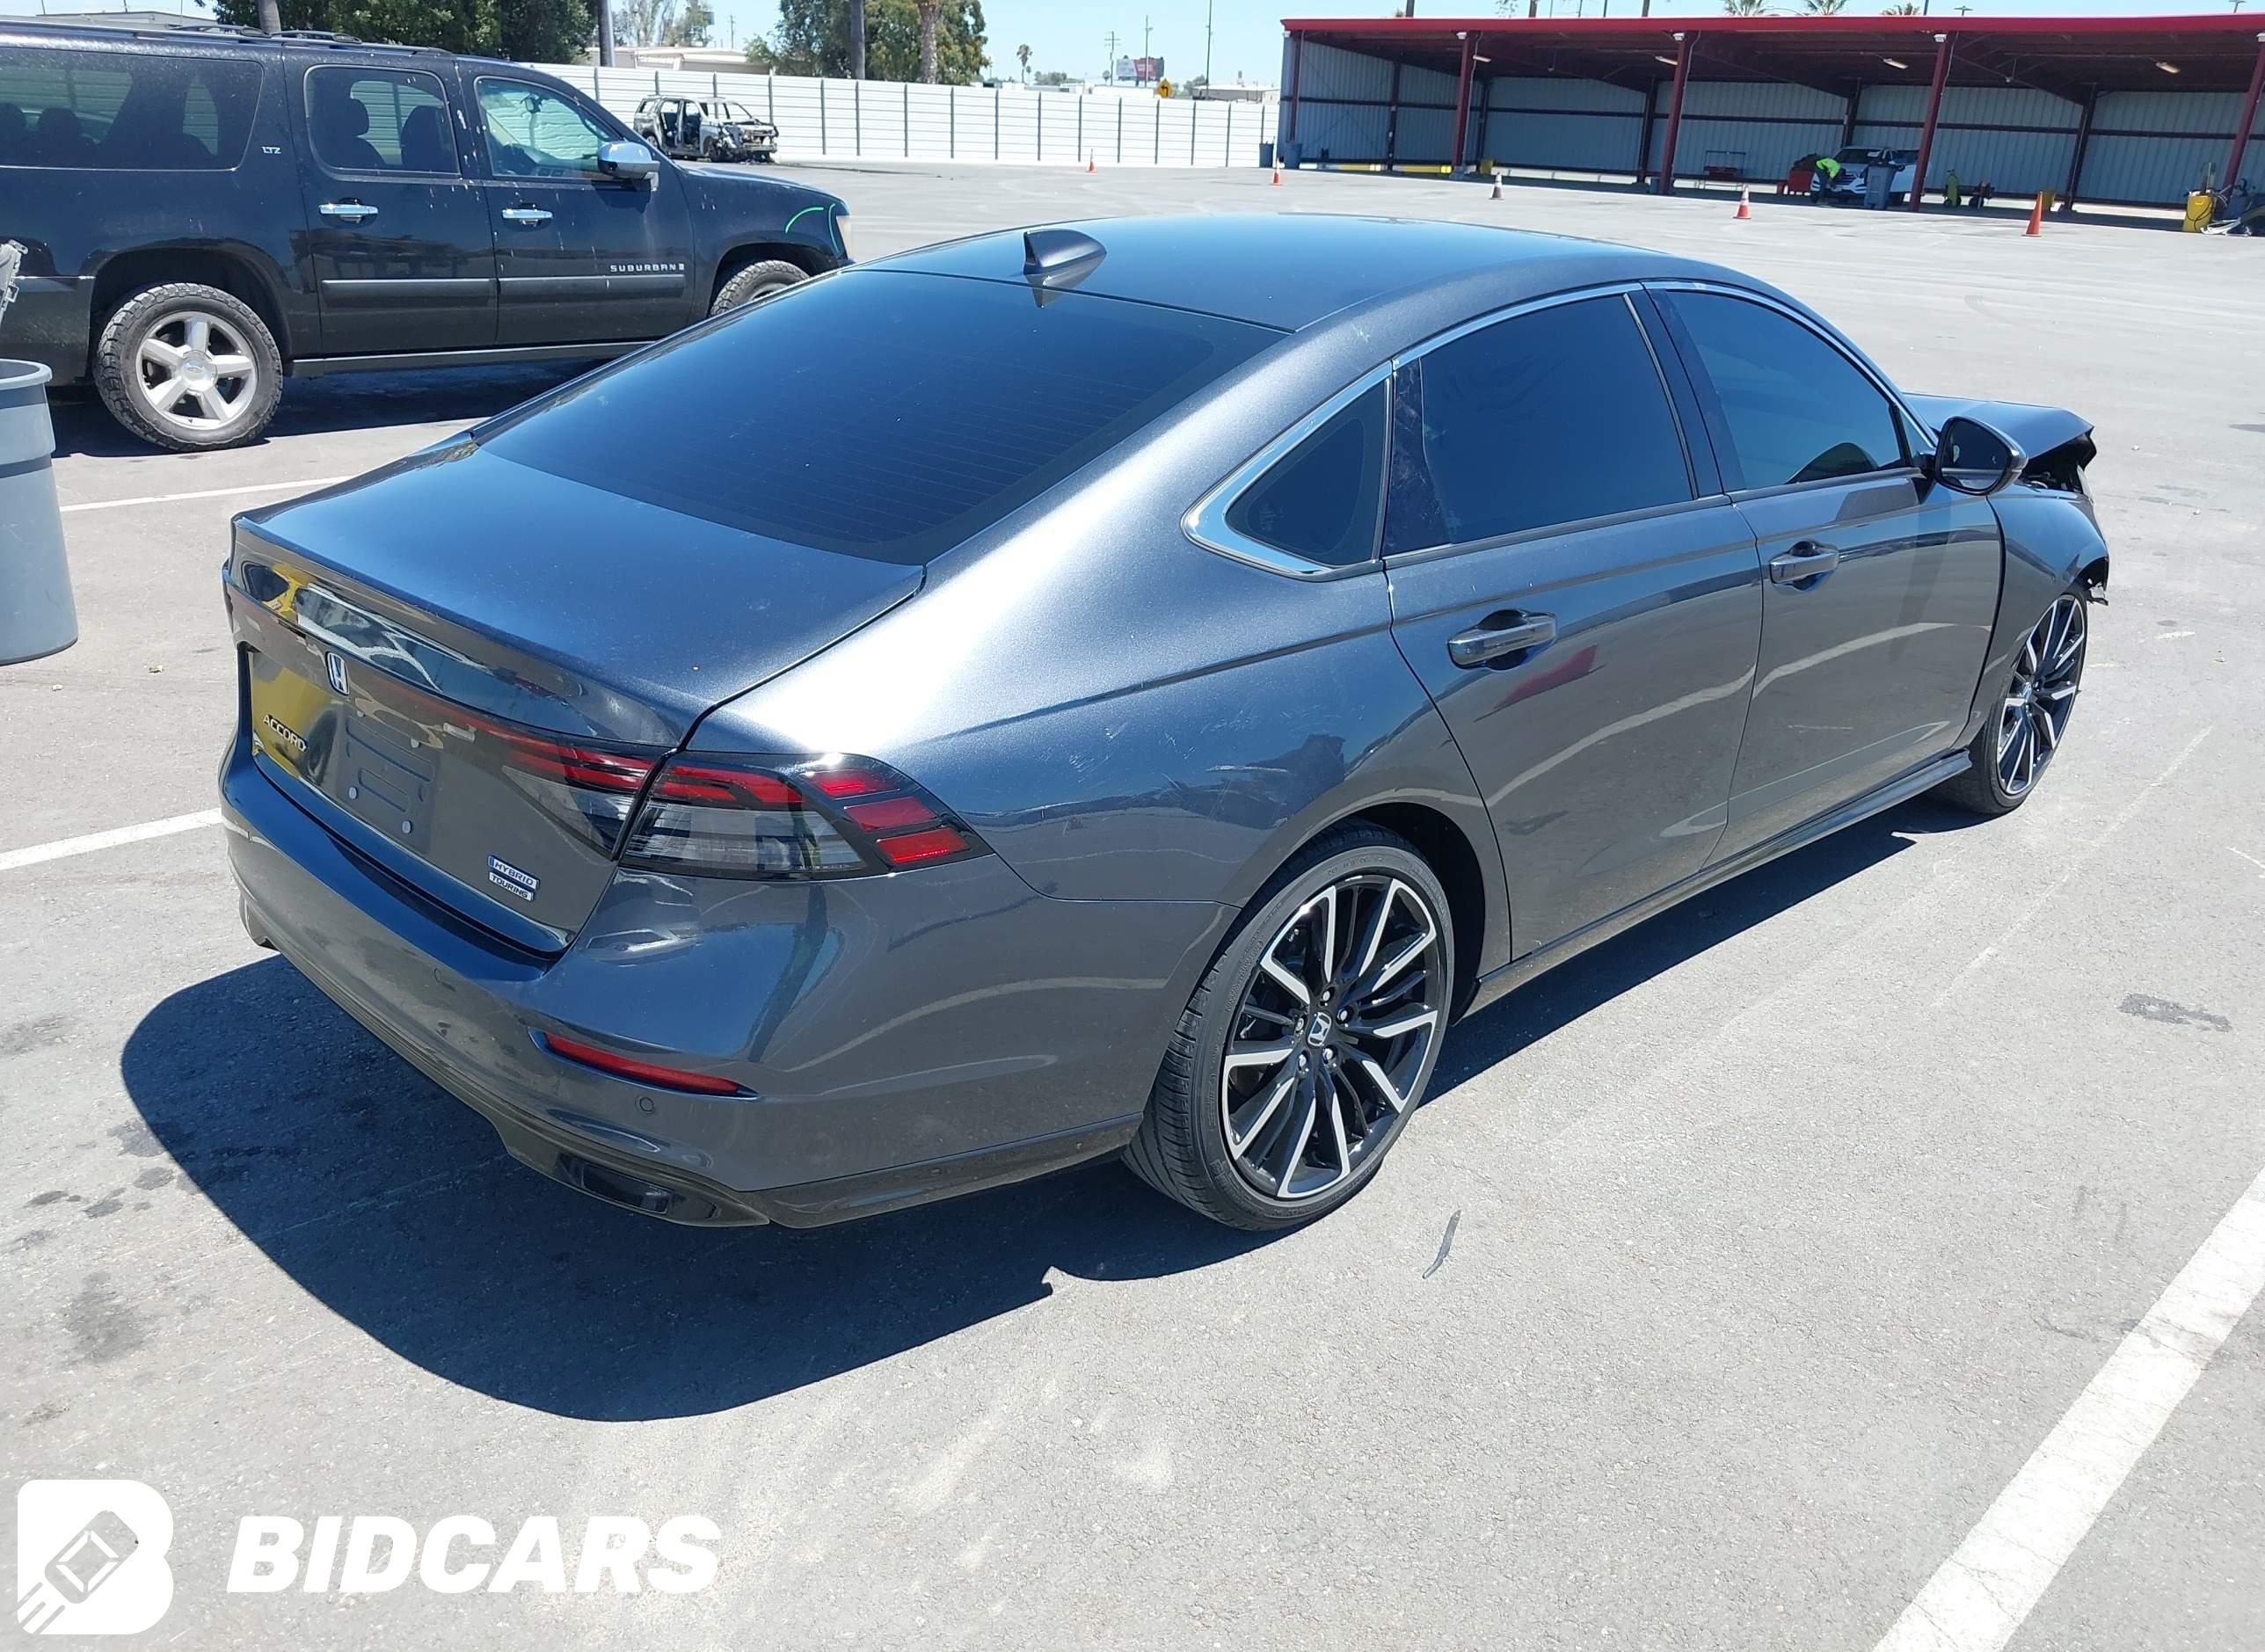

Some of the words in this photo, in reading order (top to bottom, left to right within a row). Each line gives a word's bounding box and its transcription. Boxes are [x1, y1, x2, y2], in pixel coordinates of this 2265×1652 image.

[263, 714, 307, 752] ACCORD
[494, 862, 534, 885] HYBRID
[492, 874, 528, 898] TOURING
